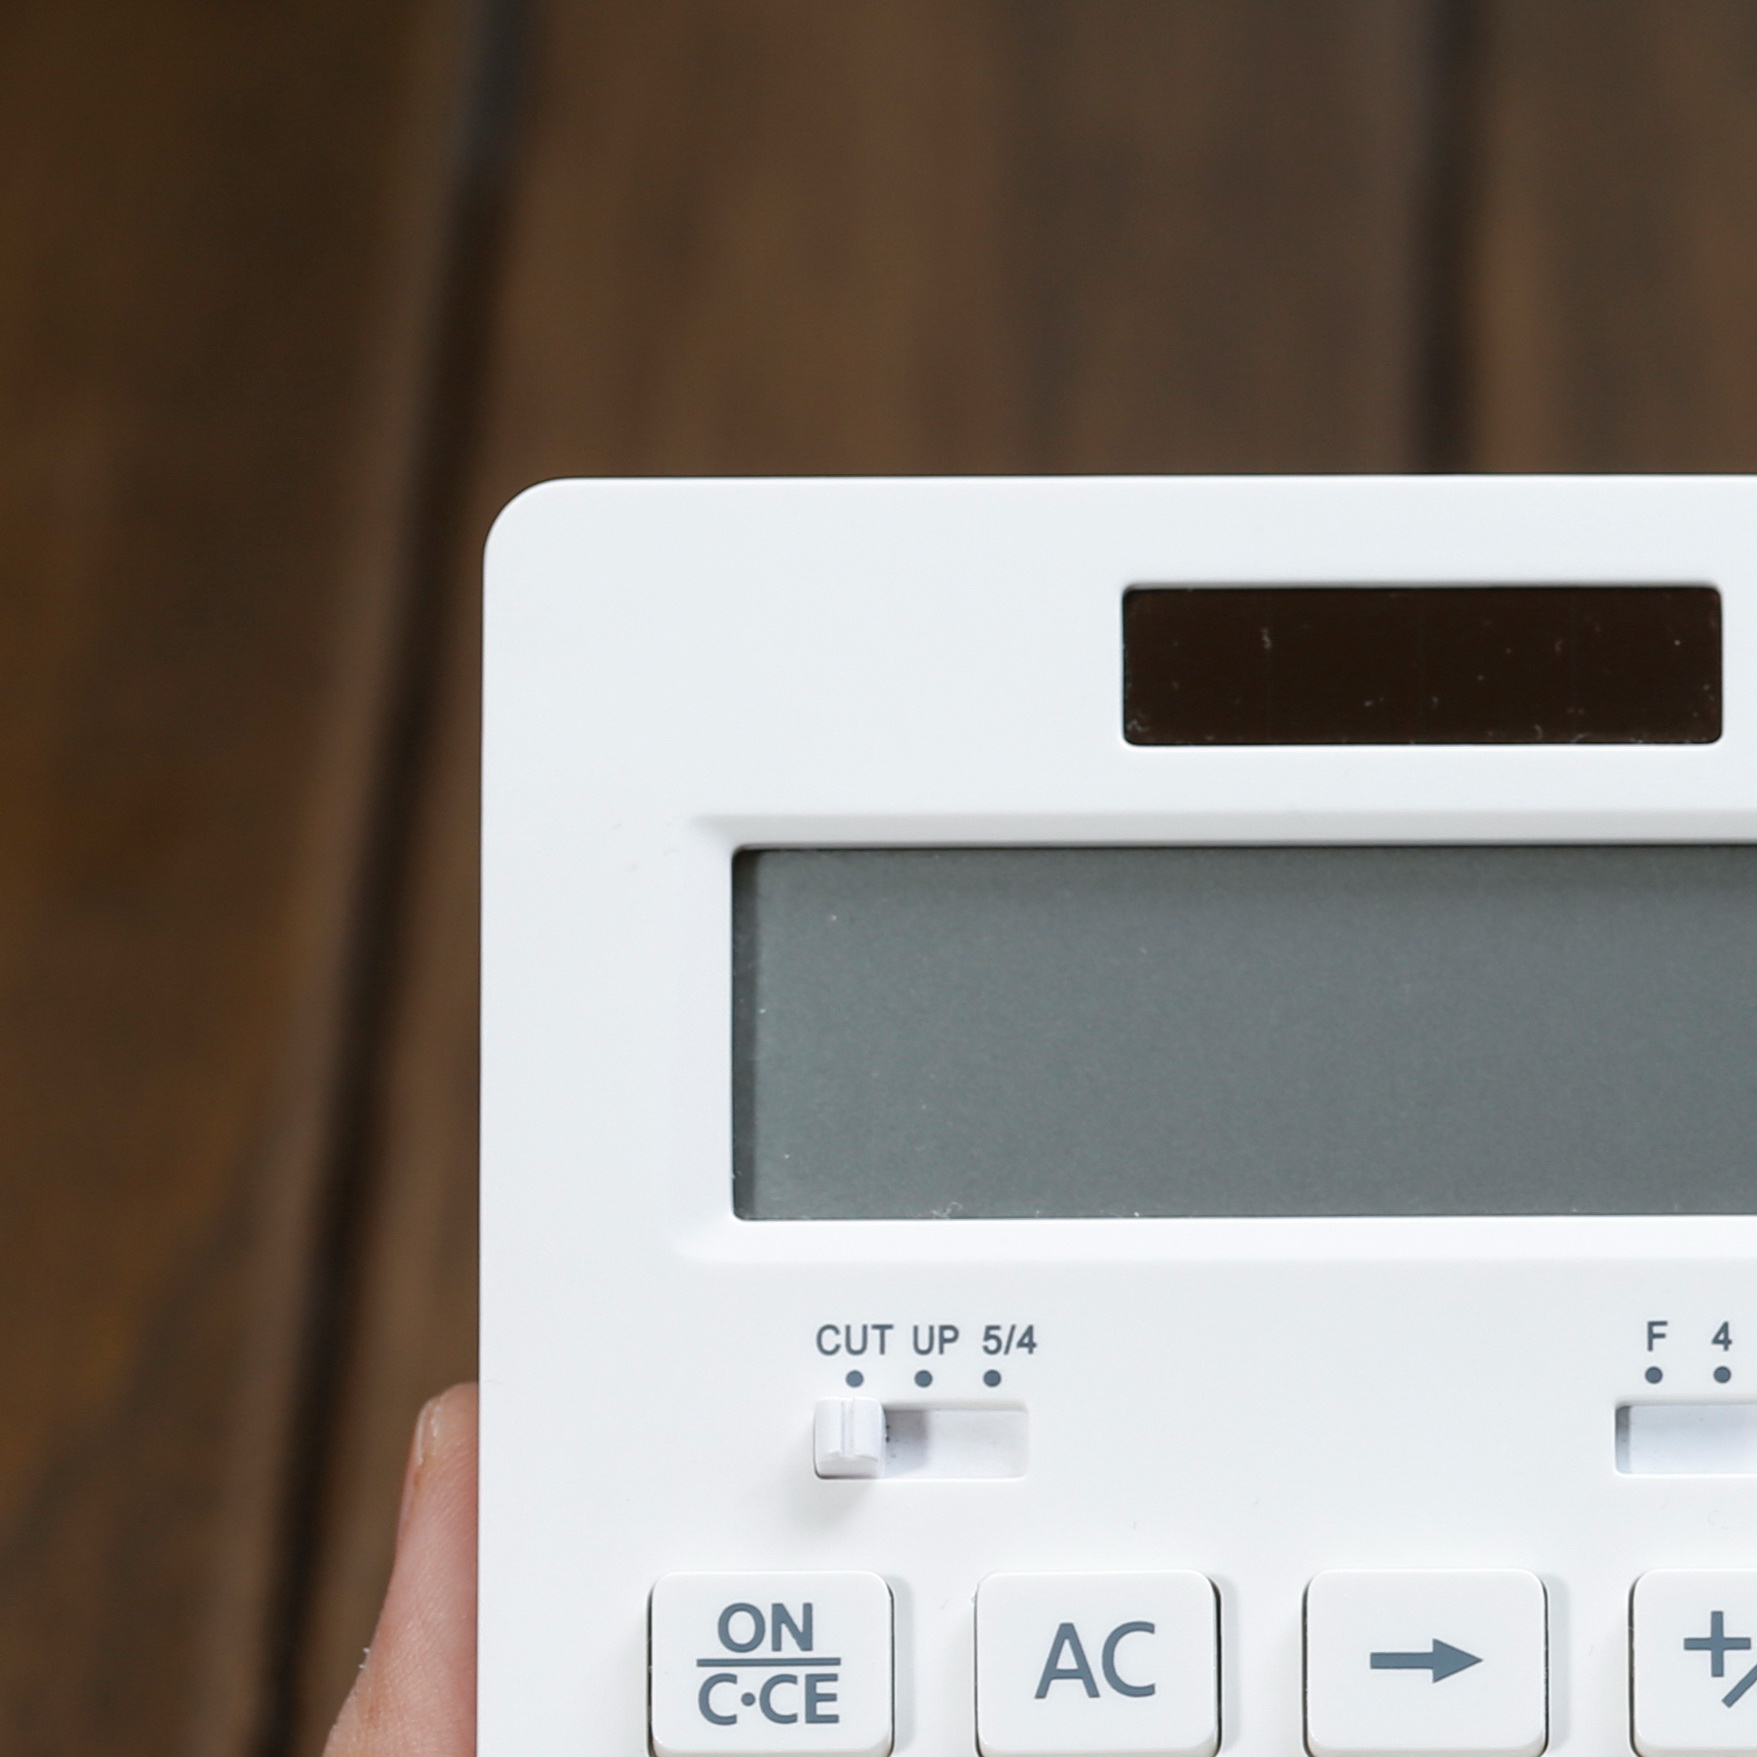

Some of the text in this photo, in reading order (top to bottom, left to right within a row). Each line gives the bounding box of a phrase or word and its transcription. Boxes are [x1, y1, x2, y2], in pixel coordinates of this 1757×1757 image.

[816, 1323, 1038, 1356] CUT UP 5/4
[1647, 1320, 1669, 1352] F
[1711, 1321, 1733, 1352] 4
[717, 1602, 814, 1653] ON
[1034, 1620, 1156, 1700] AC
